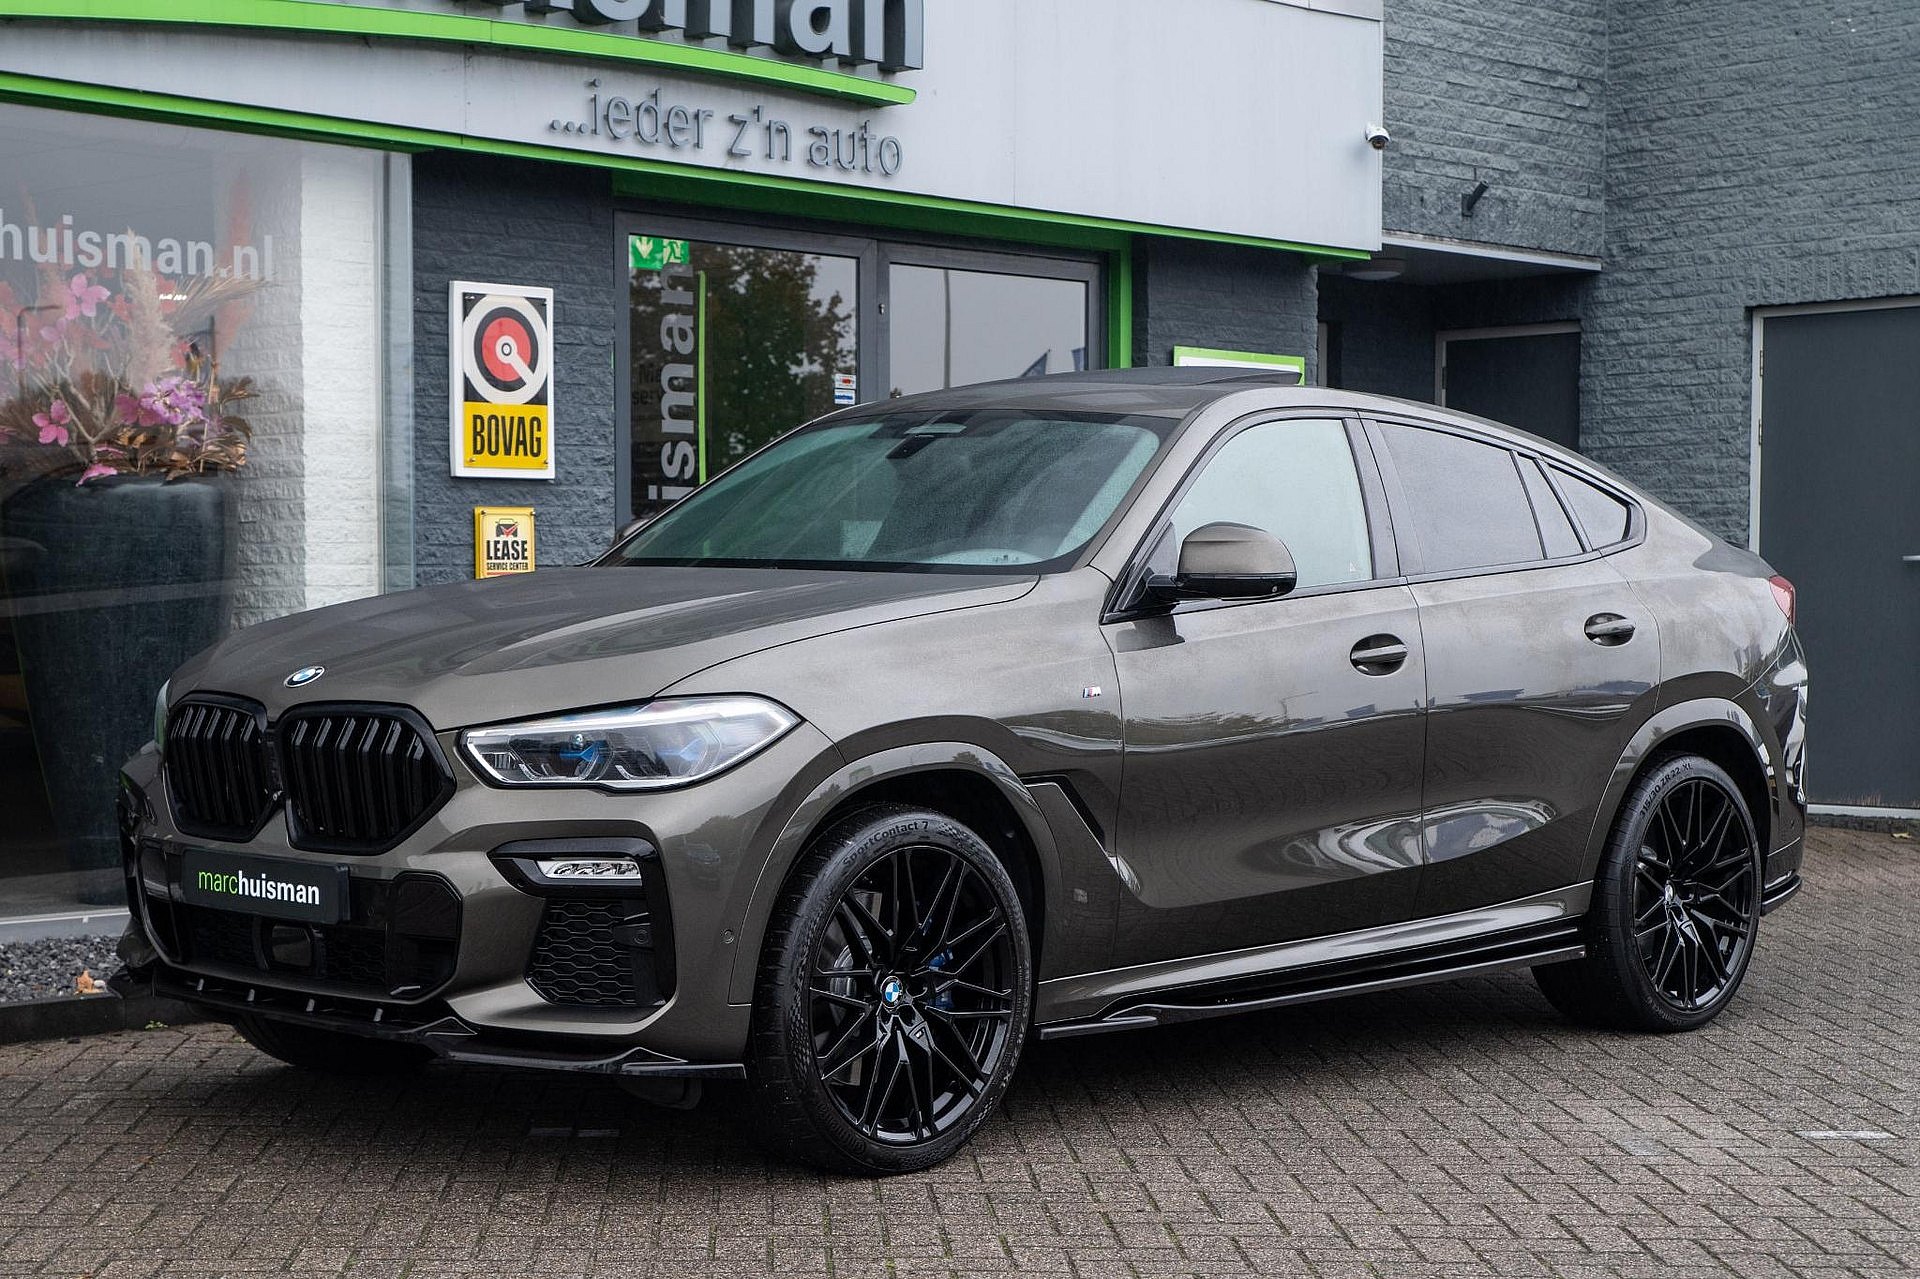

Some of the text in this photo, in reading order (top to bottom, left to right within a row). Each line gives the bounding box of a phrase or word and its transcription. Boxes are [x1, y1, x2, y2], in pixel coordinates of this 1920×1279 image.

[728, 105, 792, 161] z'n
[807, 120, 903, 176] auto
[472, 414, 541, 457] BOVAG
[486, 540, 528, 560] LEASE
[486, 562, 528, 570] SERVICE CENTER
[842, 821, 929, 865] SportContact 7
[198, 870, 320, 904] marchuisman
